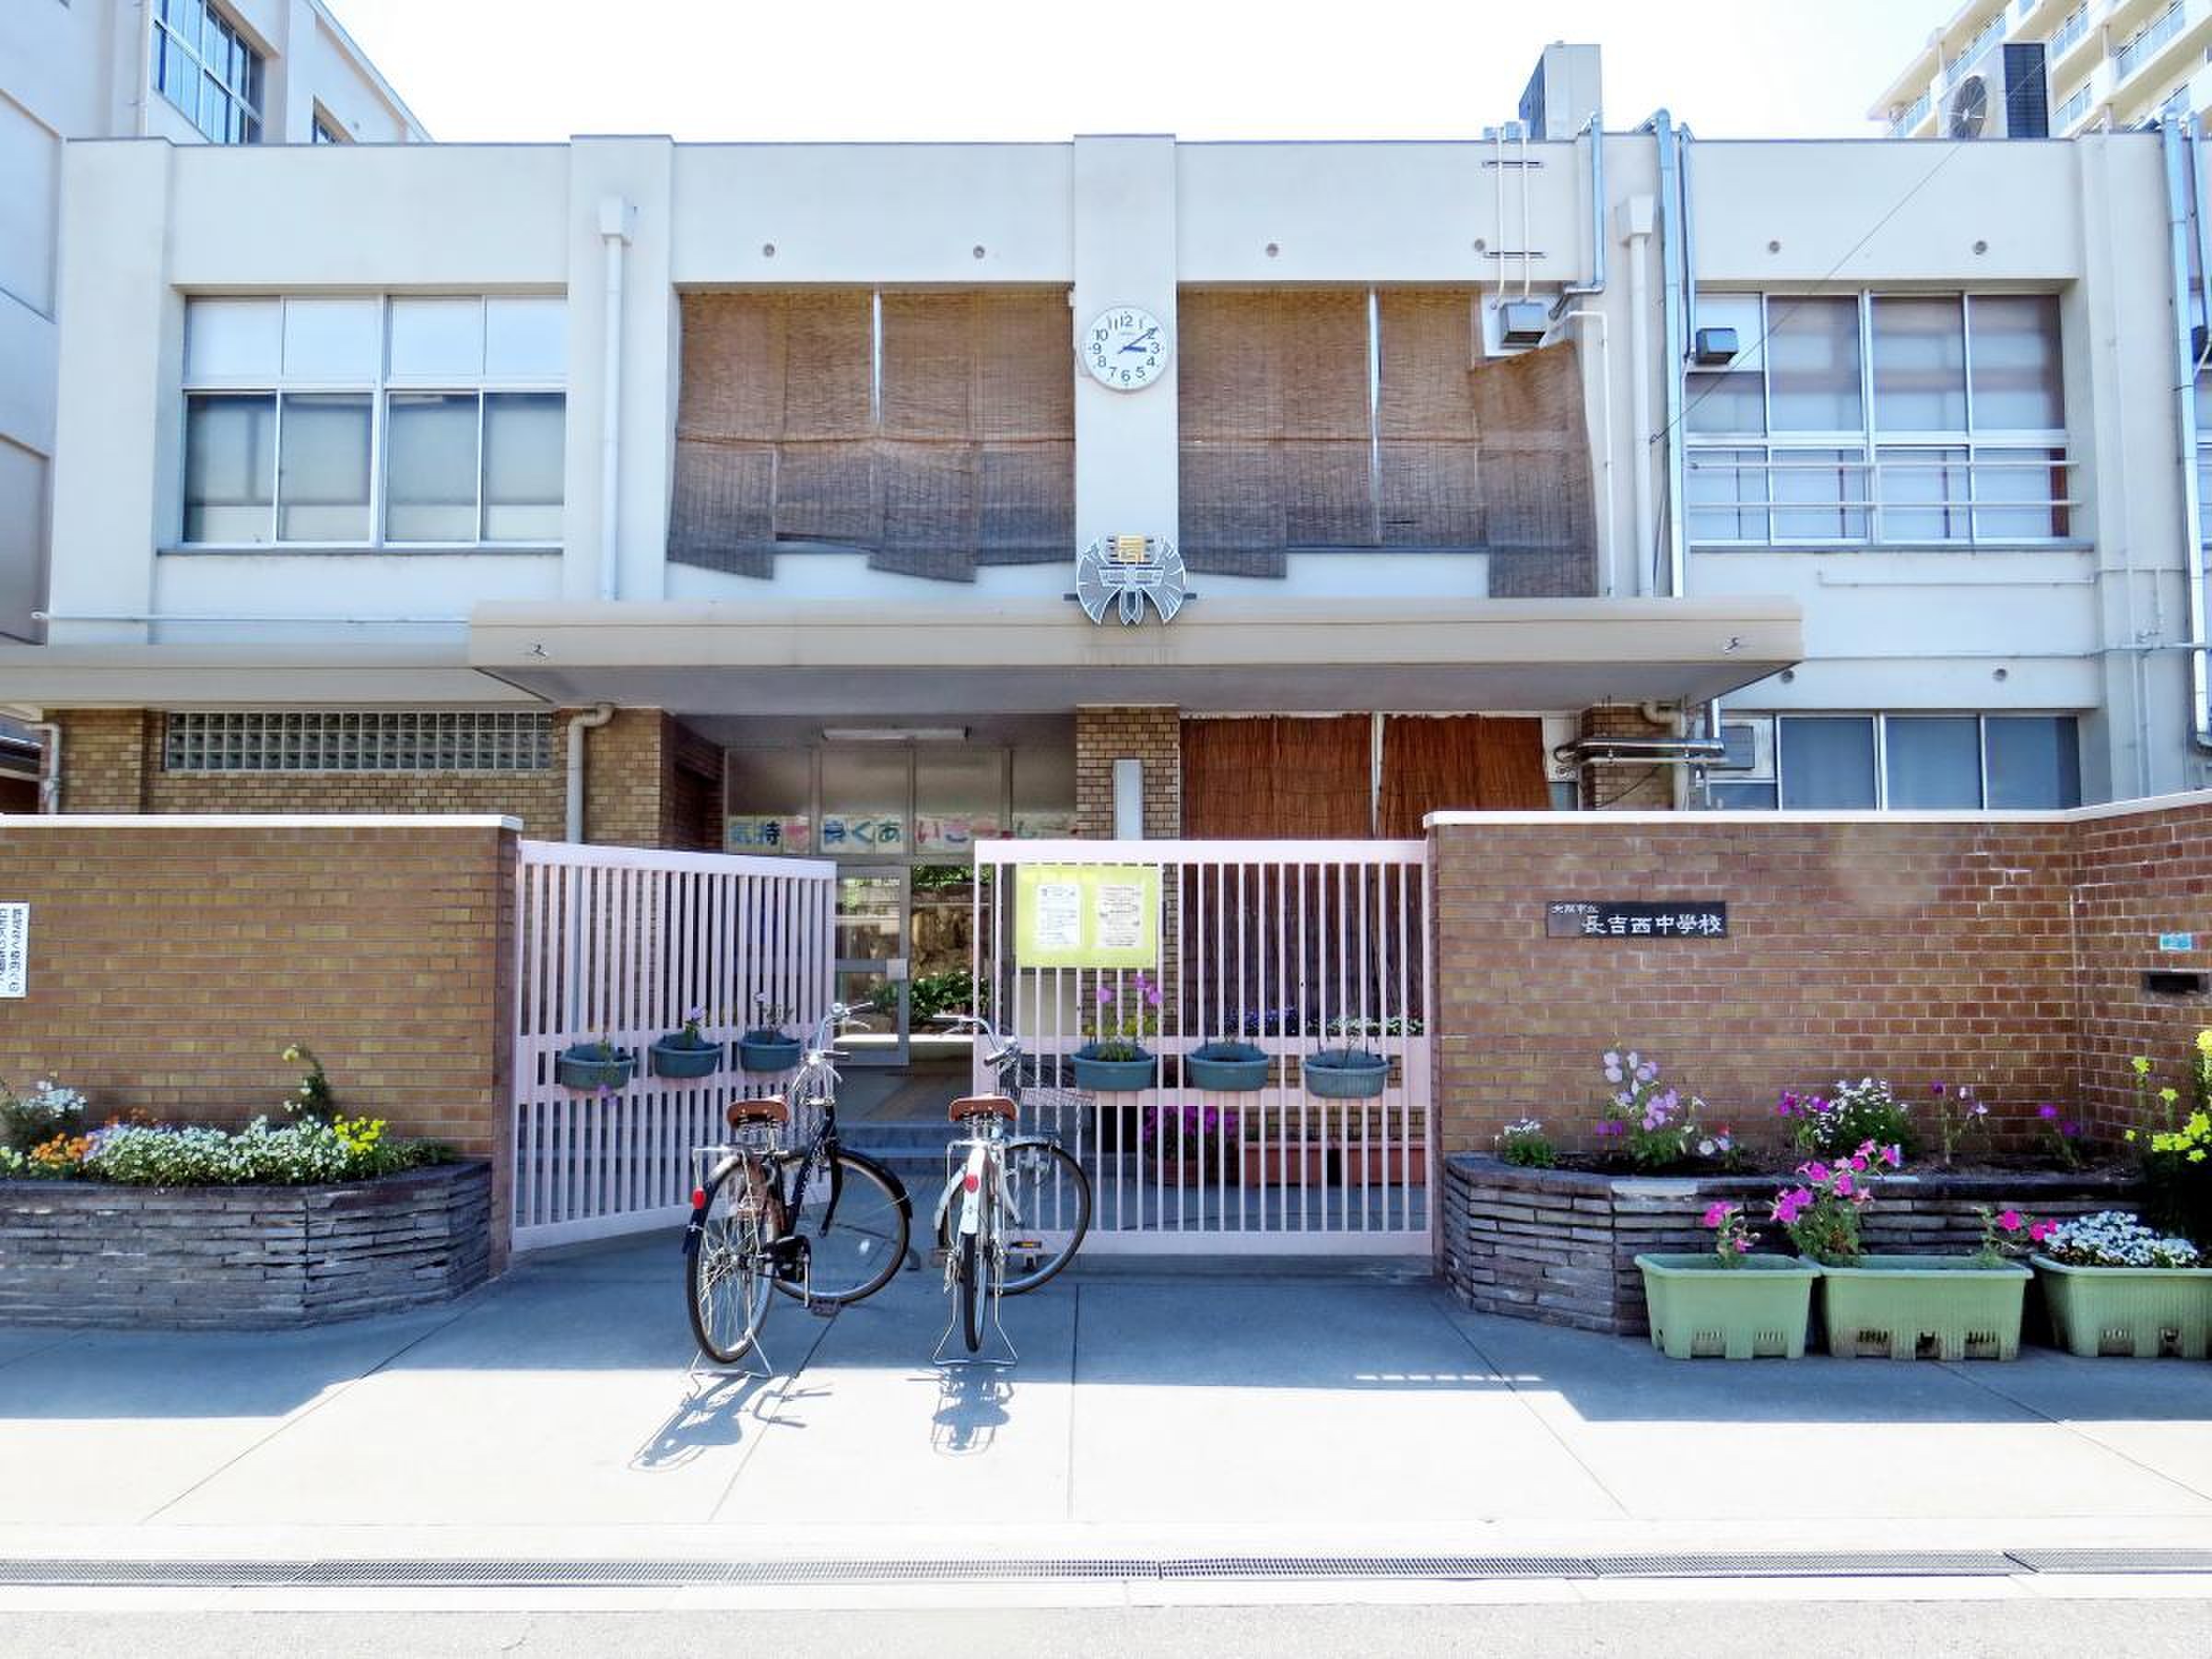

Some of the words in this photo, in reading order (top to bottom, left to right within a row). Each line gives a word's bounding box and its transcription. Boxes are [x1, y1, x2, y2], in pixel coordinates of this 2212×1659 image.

[1106, 316, 1118, 330] 11
[1120, 314, 1133, 326] 12
[1095, 329, 1108, 341] 10
[1092, 343, 1101, 355] 9
[1150, 341, 1160, 354] 3
[1097, 356, 1106, 368] 8
[1146, 357, 1155, 367] 4
[1109, 367, 1117, 377] 7
[1121, 370, 1131, 382] 6
[1135, 367, 1146, 378] 5
